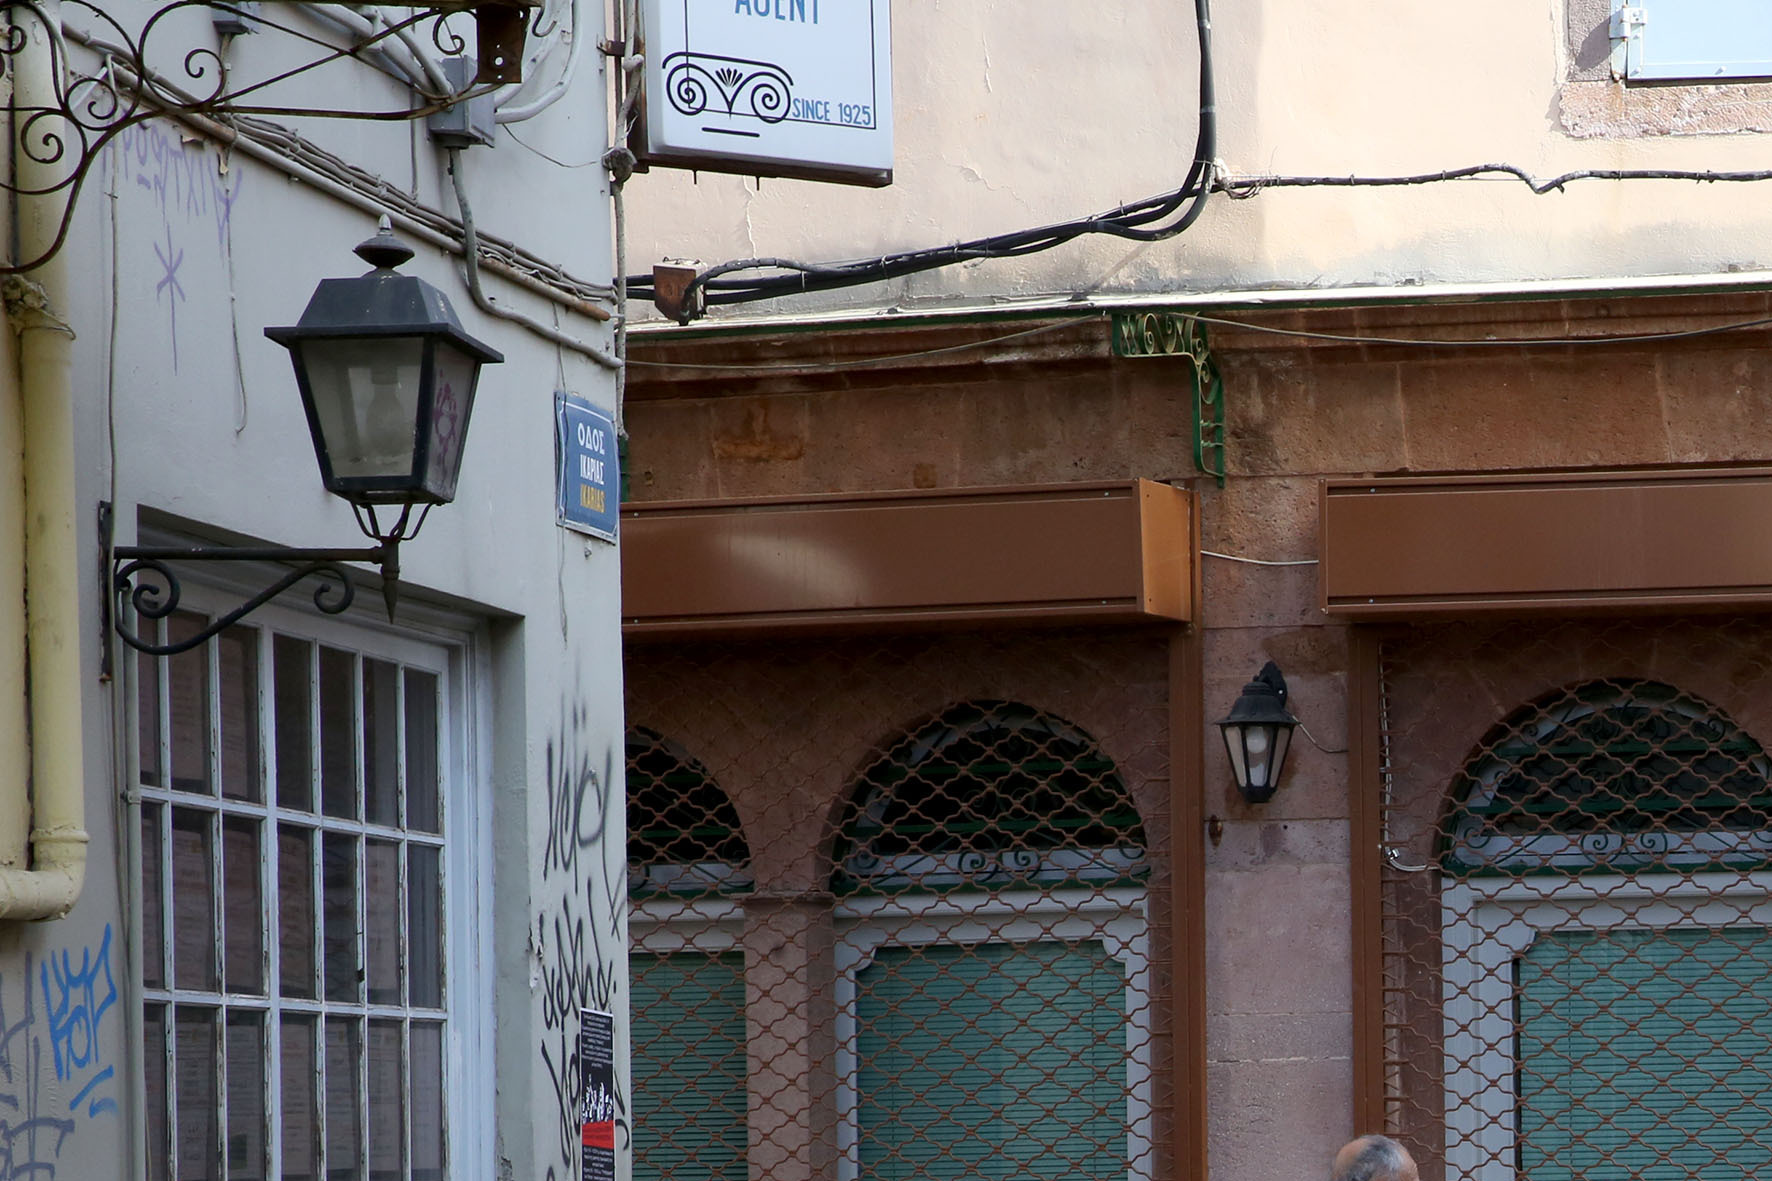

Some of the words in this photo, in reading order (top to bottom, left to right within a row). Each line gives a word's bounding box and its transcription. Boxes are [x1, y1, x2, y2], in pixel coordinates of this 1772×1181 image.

[792, 98, 830, 121] SINCE
[838, 102, 871, 125] 1925
[578, 422, 605, 455] ΟΔΟΣ
[580, 454, 604, 485] ΙΚΑΡΙΑΣ
[580, 483, 606, 513] IKARIAS
